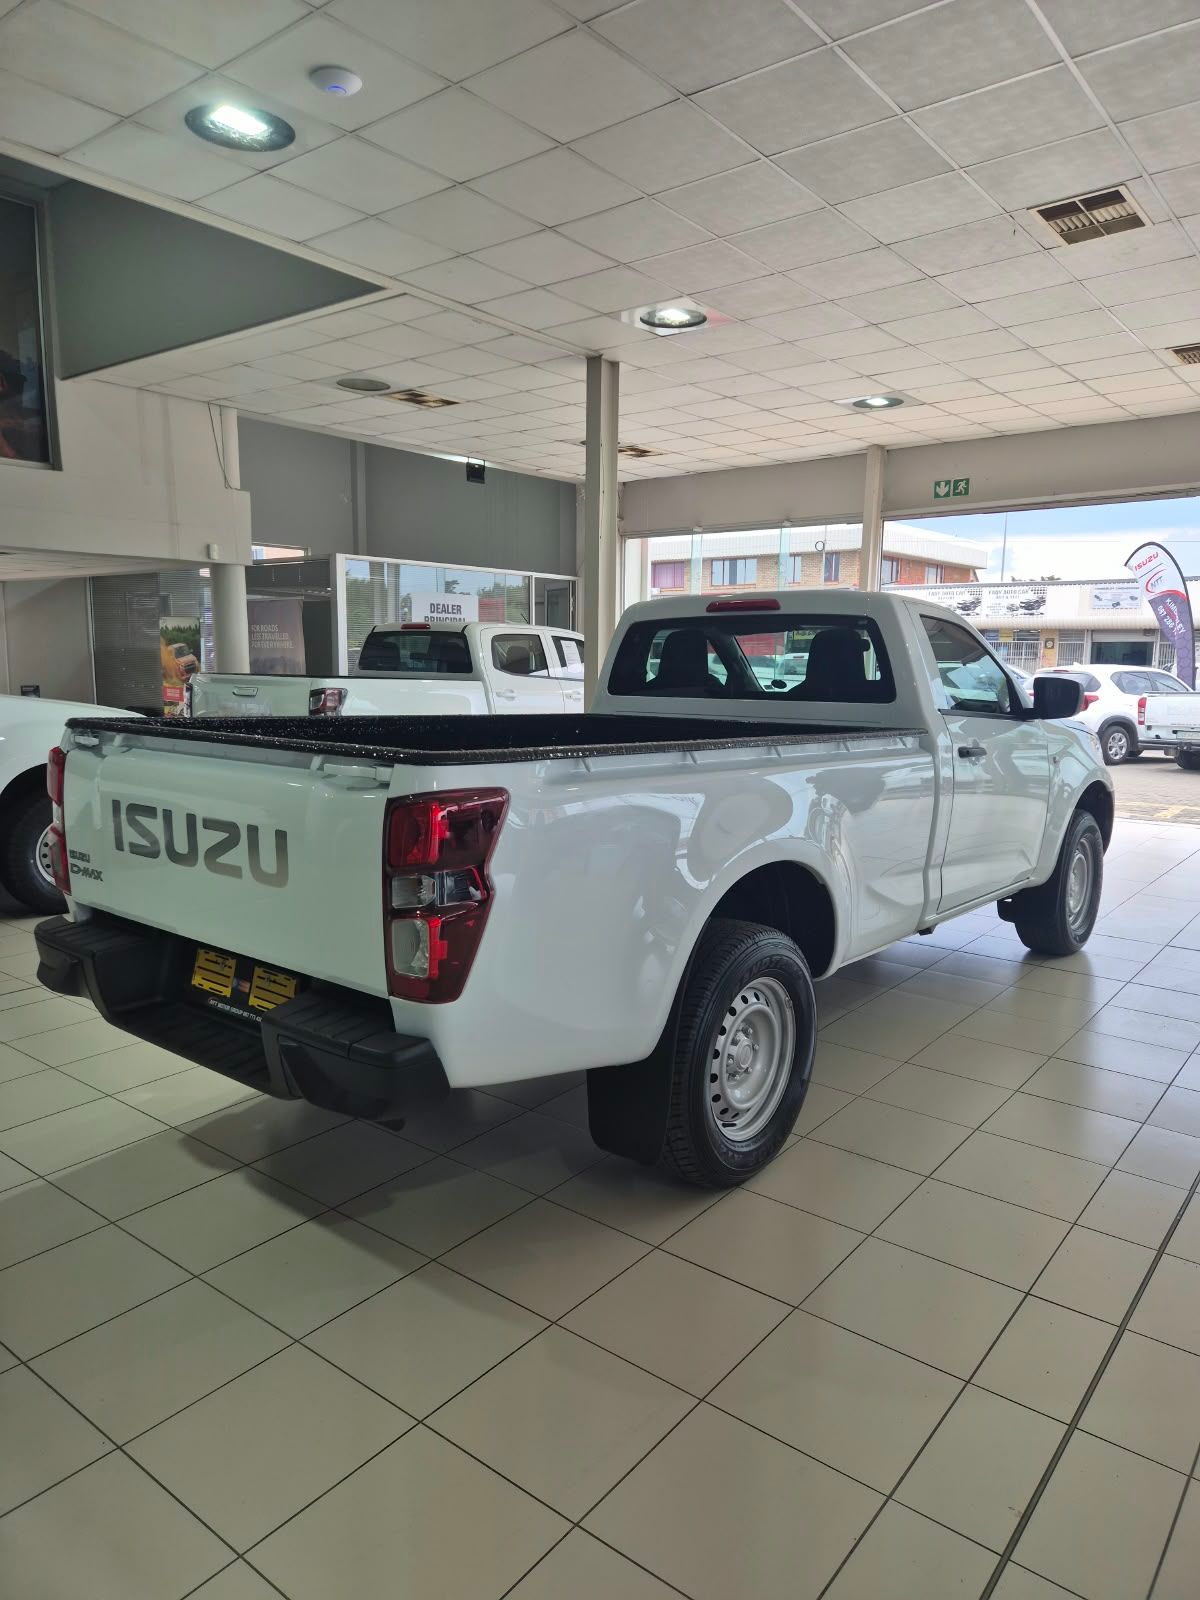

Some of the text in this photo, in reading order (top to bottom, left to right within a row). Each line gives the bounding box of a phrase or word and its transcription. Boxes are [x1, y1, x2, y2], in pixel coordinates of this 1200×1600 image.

[1134, 552, 1159, 571] ISUZU
[1150, 576, 1163, 588] NTT
[430, 603, 462, 615] DEALER
[112, 799, 289, 888] ISUZU
[69, 849, 90, 863] ISUZU
[217, 1002, 230, 1011] MOTOR
[231, 1006, 243, 1015] GROUP
